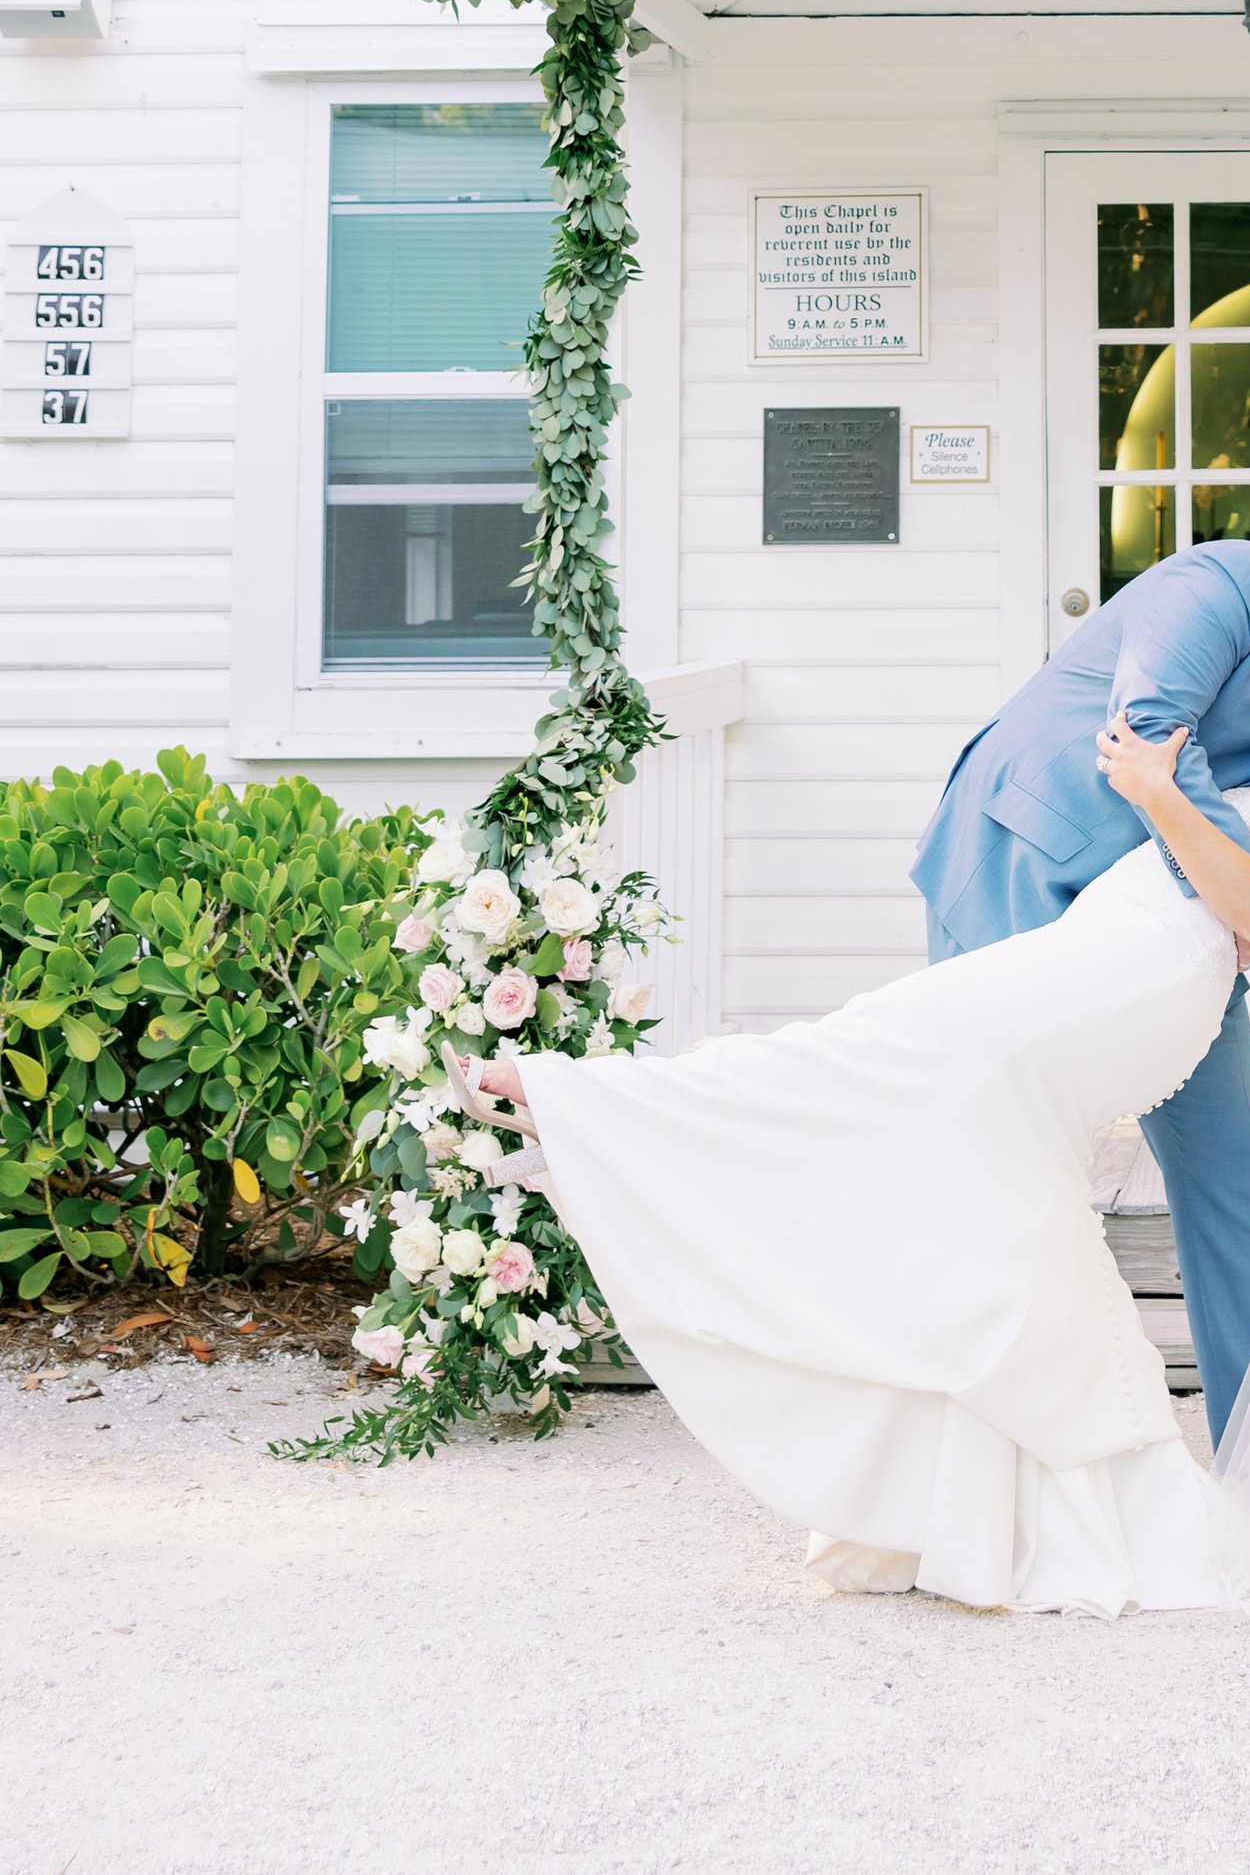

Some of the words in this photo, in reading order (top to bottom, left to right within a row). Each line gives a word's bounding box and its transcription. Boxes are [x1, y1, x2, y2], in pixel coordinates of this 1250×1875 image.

[780, 204, 818, 219] This
[824, 204, 878, 219] Chapel
[883, 204, 898, 217] is
[785, 223, 820, 236] open
[826, 220, 864, 236] daily
[869, 220, 892, 234] for
[765, 238, 828, 250] reverent
[835, 240, 861, 250] use
[867, 237, 883, 252] by
[889, 236, 912, 251] the
[38, 246, 104, 280] 456
[785, 254, 857, 266] residents
[863, 253, 891, 265] and
[759, 270, 816, 283] visitors
[821, 269, 835, 282] of
[840, 269, 867, 283] this
[872, 269, 917, 281] island
[37, 293, 103, 328] 556
[795, 293, 882, 312] HOURS
[833, 319, 846, 330] to
[768, 334, 812, 350] Sunday
[815, 333, 858, 347] Service
[46, 342, 90, 376] 57
[44, 390, 88, 424] 37
[924, 432, 975, 448] Please
[931, 451, 969, 462] Silence
[921, 464, 978, 476] Cellphones
